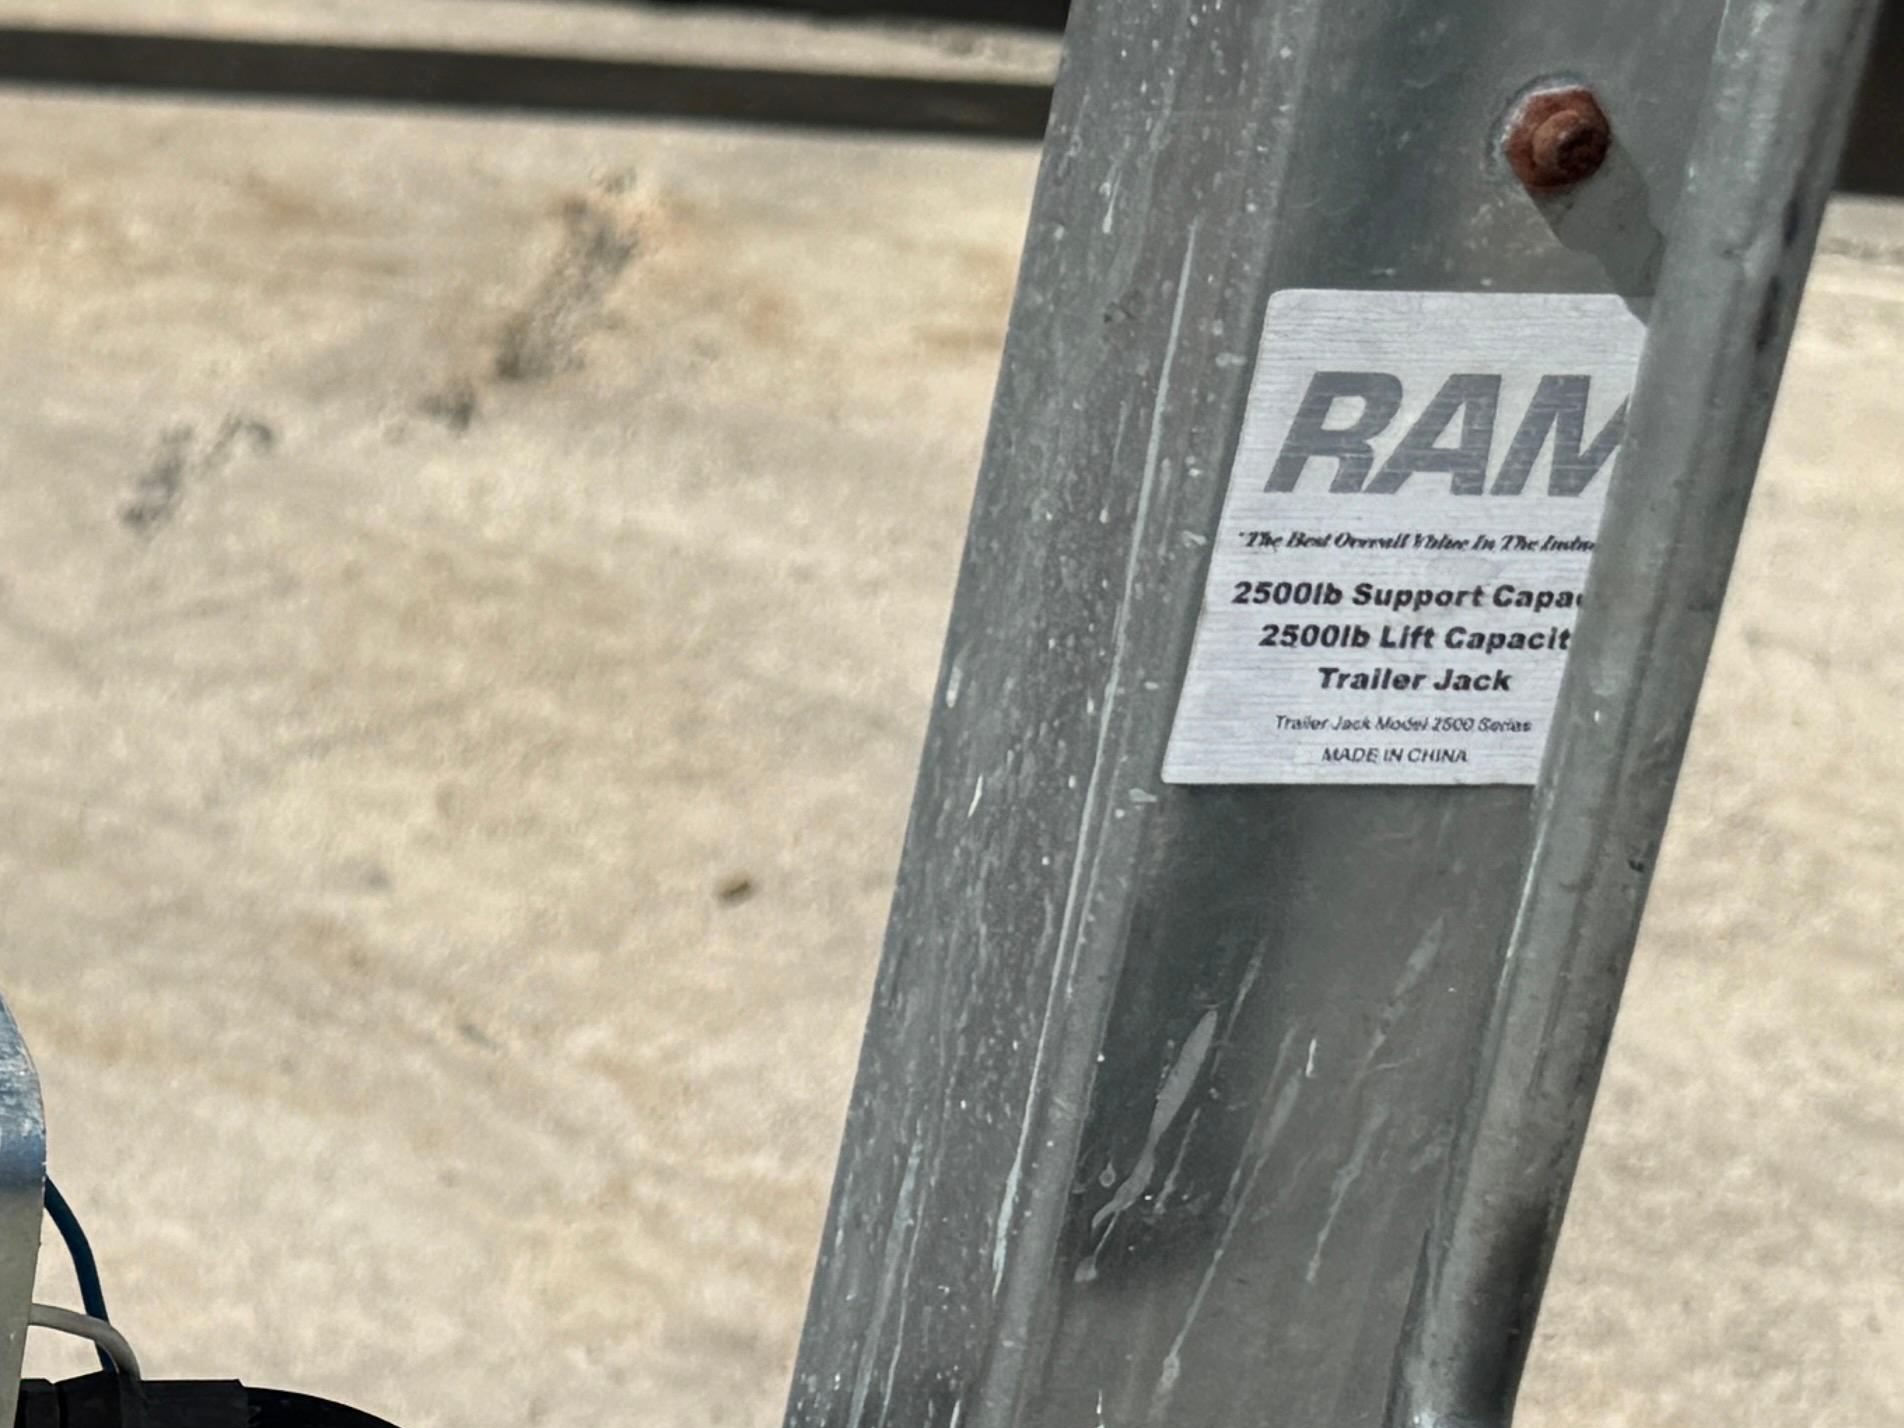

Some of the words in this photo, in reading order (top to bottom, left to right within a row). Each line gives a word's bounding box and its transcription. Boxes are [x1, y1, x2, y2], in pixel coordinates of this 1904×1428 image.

[1263, 371, 1631, 497] RAM
[1500, 534, 1539, 551] The
[1231, 581, 1342, 605] 2500lb
[1352, 582, 1484, 612] Support
[1259, 624, 1370, 648] 2500lb
[1380, 625, 1435, 649] Lift
[1444, 626, 1571, 654] Capacit
[1318, 667, 1427, 690] Trailer
[1433, 669, 1512, 691] Jack
[1276, 715, 1329, 730] Trailer
[1331, 716, 1370, 731] Jack
[1375, 716, 1428, 731] Model
[1431, 717, 1474, 732] 2500
[1478, 718, 1532, 733] Series
[1322, 748, 1378, 763] MADE
[1383, 749, 1401, 763] IN
[1407, 748, 1468, 763] CHINA
